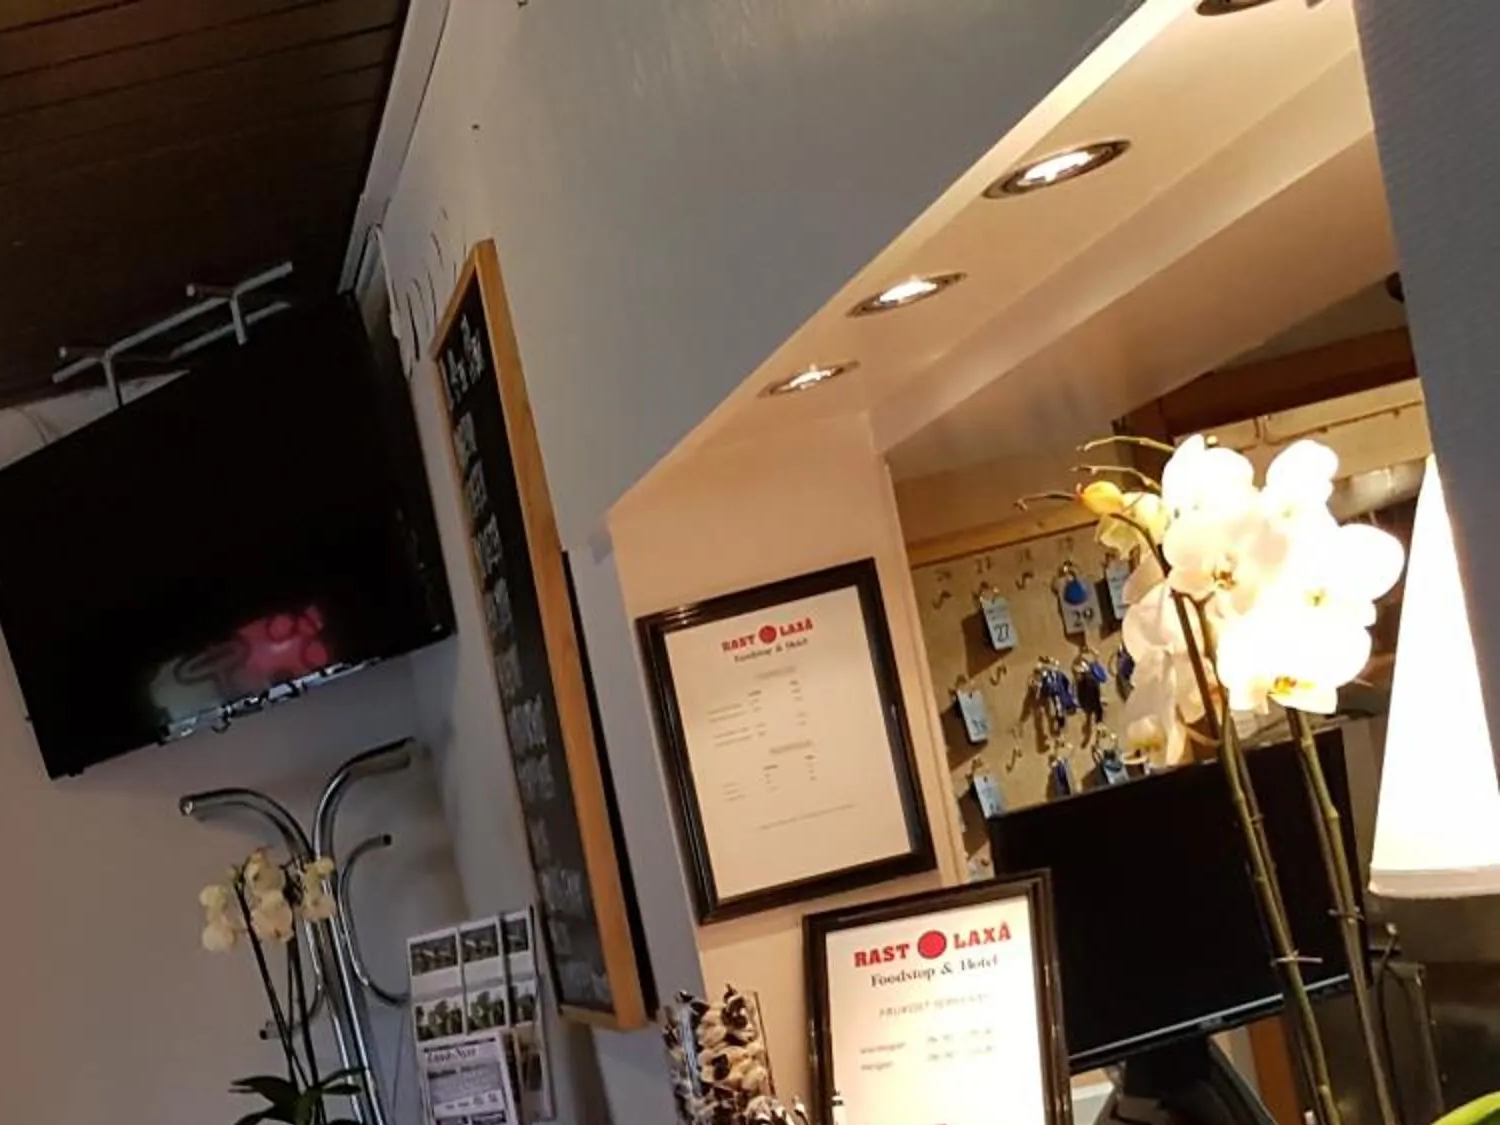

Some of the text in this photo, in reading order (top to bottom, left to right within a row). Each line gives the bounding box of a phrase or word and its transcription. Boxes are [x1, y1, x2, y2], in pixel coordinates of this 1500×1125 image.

[1071, 607, 1094, 627] 29
[853, 921, 1011, 968] RAST LAXÅ
[870, 954, 999, 988] Foodstop & Hotel
